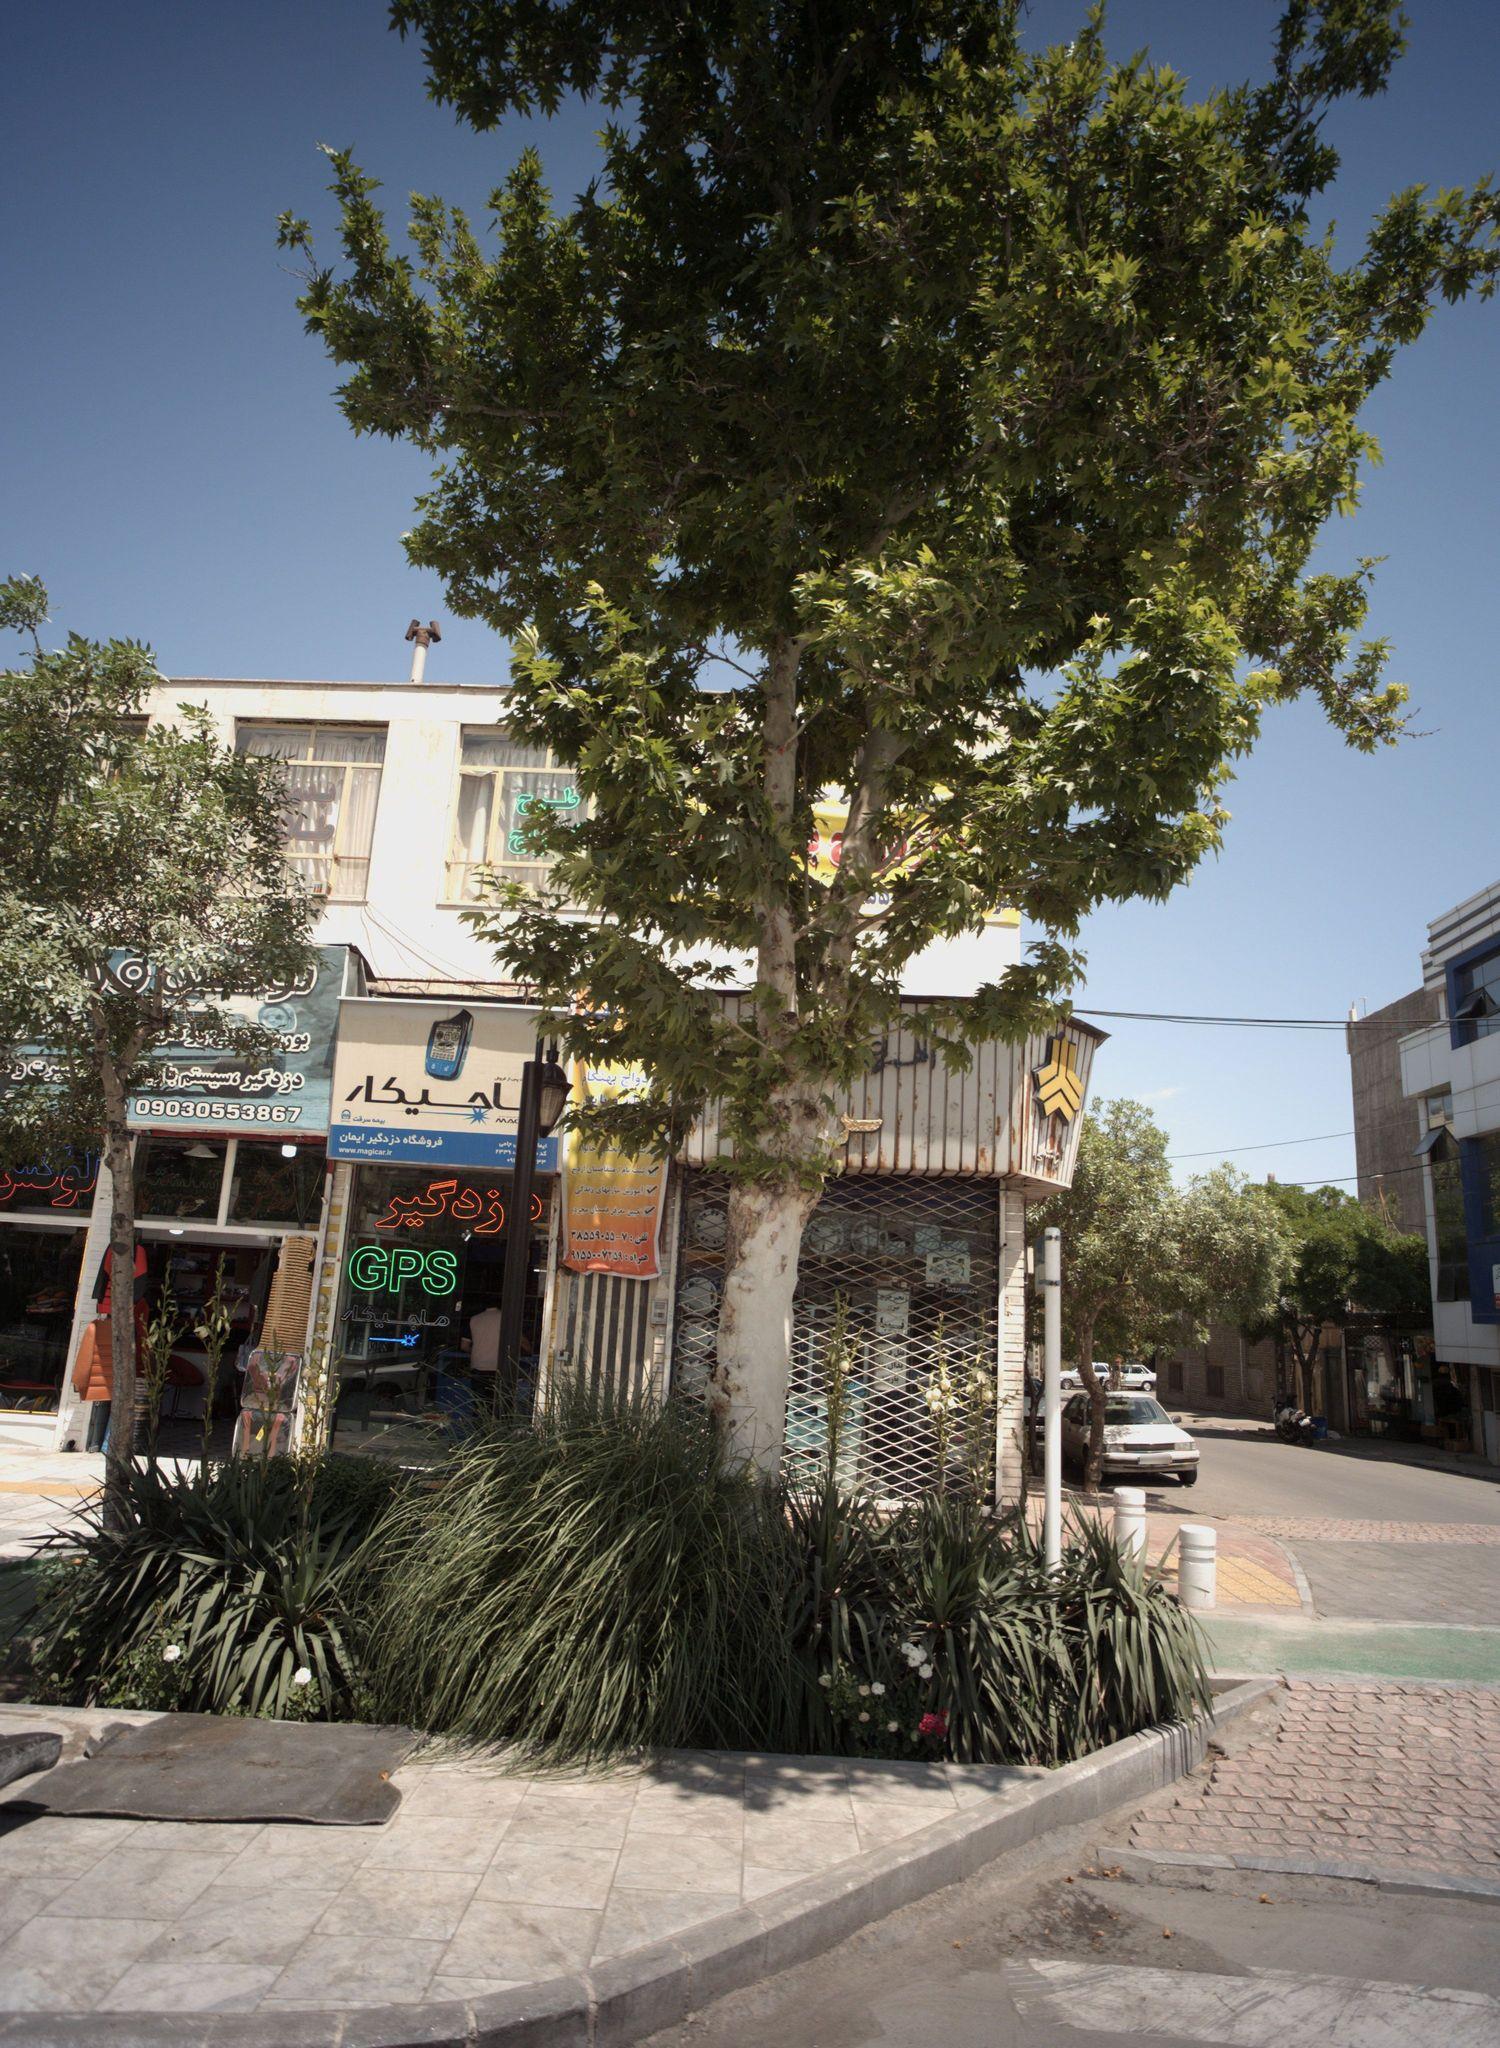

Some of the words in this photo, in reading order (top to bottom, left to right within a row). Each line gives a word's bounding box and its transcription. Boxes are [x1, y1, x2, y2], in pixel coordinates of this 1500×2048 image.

[135, 1099, 302, 1123] 09030553867
[339, 1131, 365, 1143] ایمان
[367, 1133, 401, 1146] دزدگیر
[402, 1134, 443, 1148] فروشگاه
[338, 1146, 393, 1156] www.magicar.ir
[349, 1245, 458, 1296] GPS
